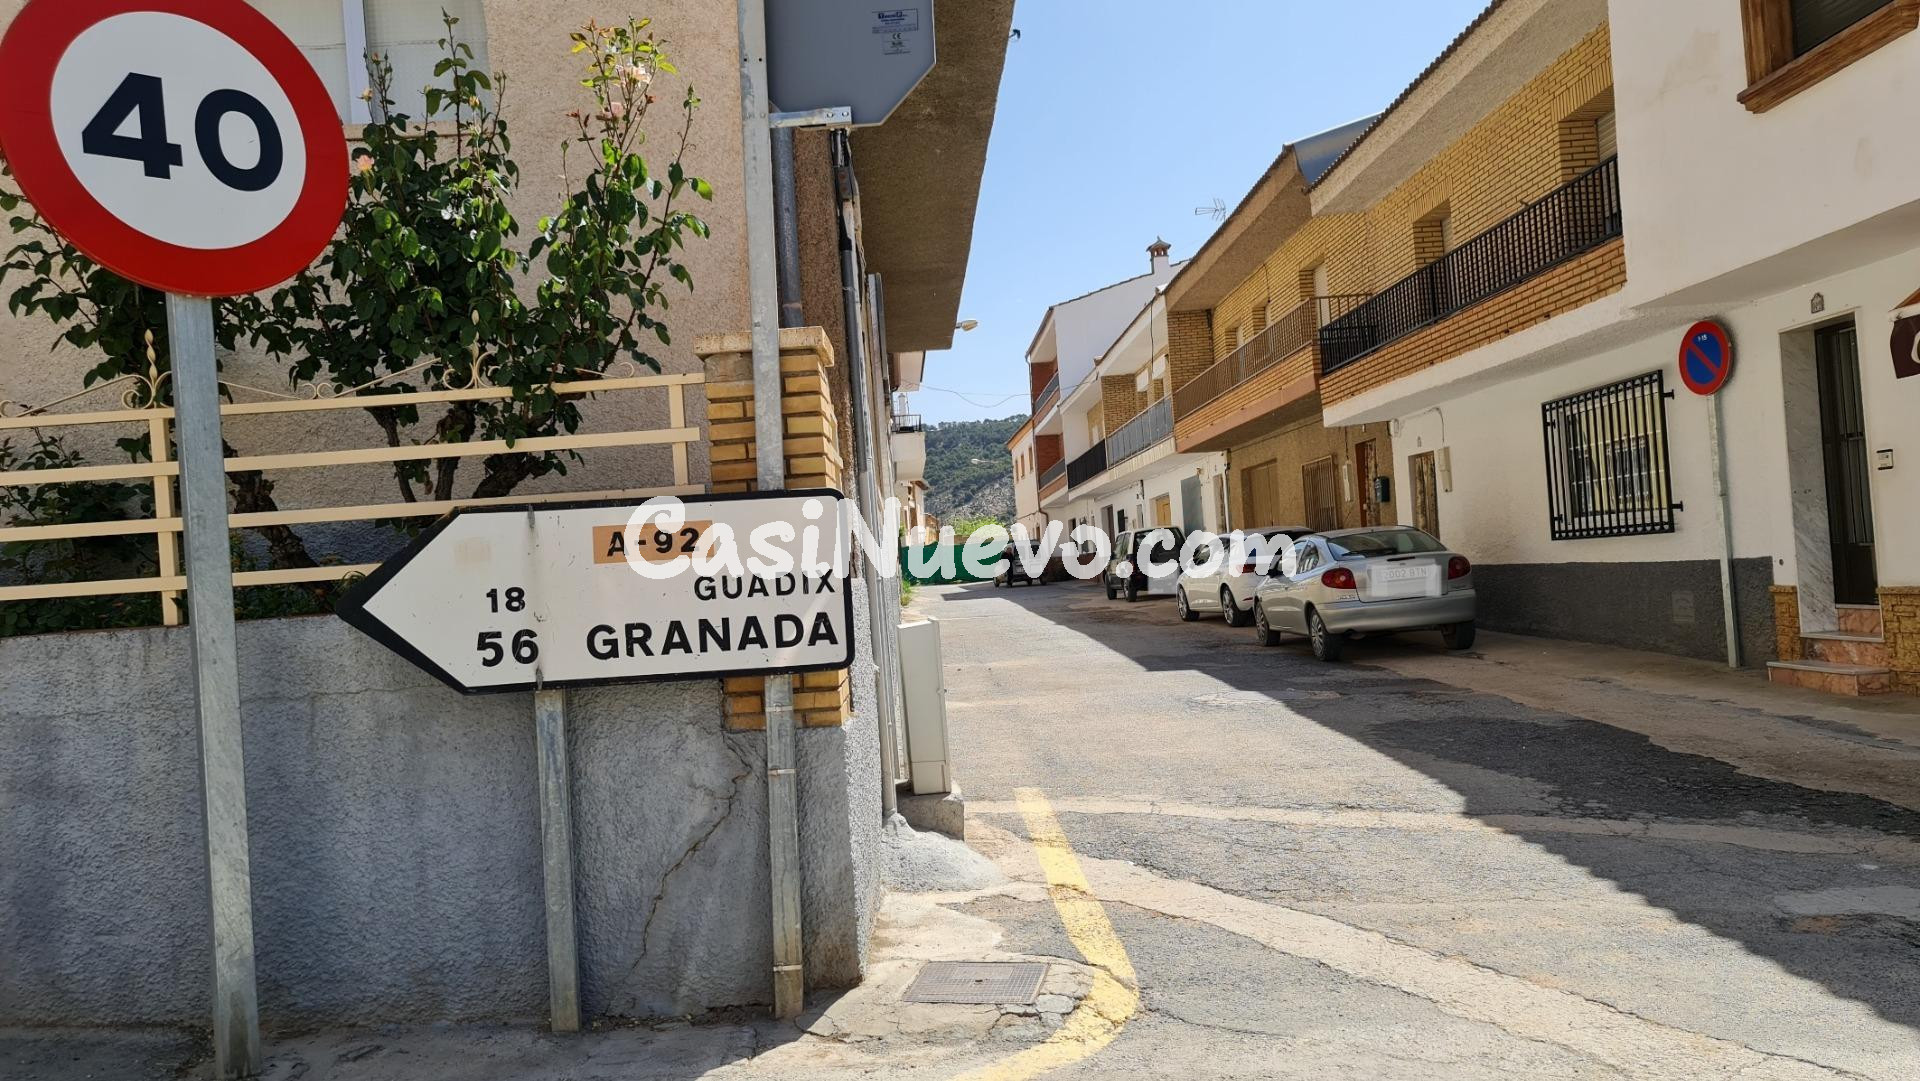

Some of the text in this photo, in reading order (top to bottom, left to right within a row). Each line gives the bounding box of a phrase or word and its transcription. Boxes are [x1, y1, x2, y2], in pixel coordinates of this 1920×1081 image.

[81, 71, 284, 192] 40
[606, 527, 700, 558] A-92
[486, 568, 836, 613] 18 GUADIX
[477, 611, 839, 667] 56 GRANADA
